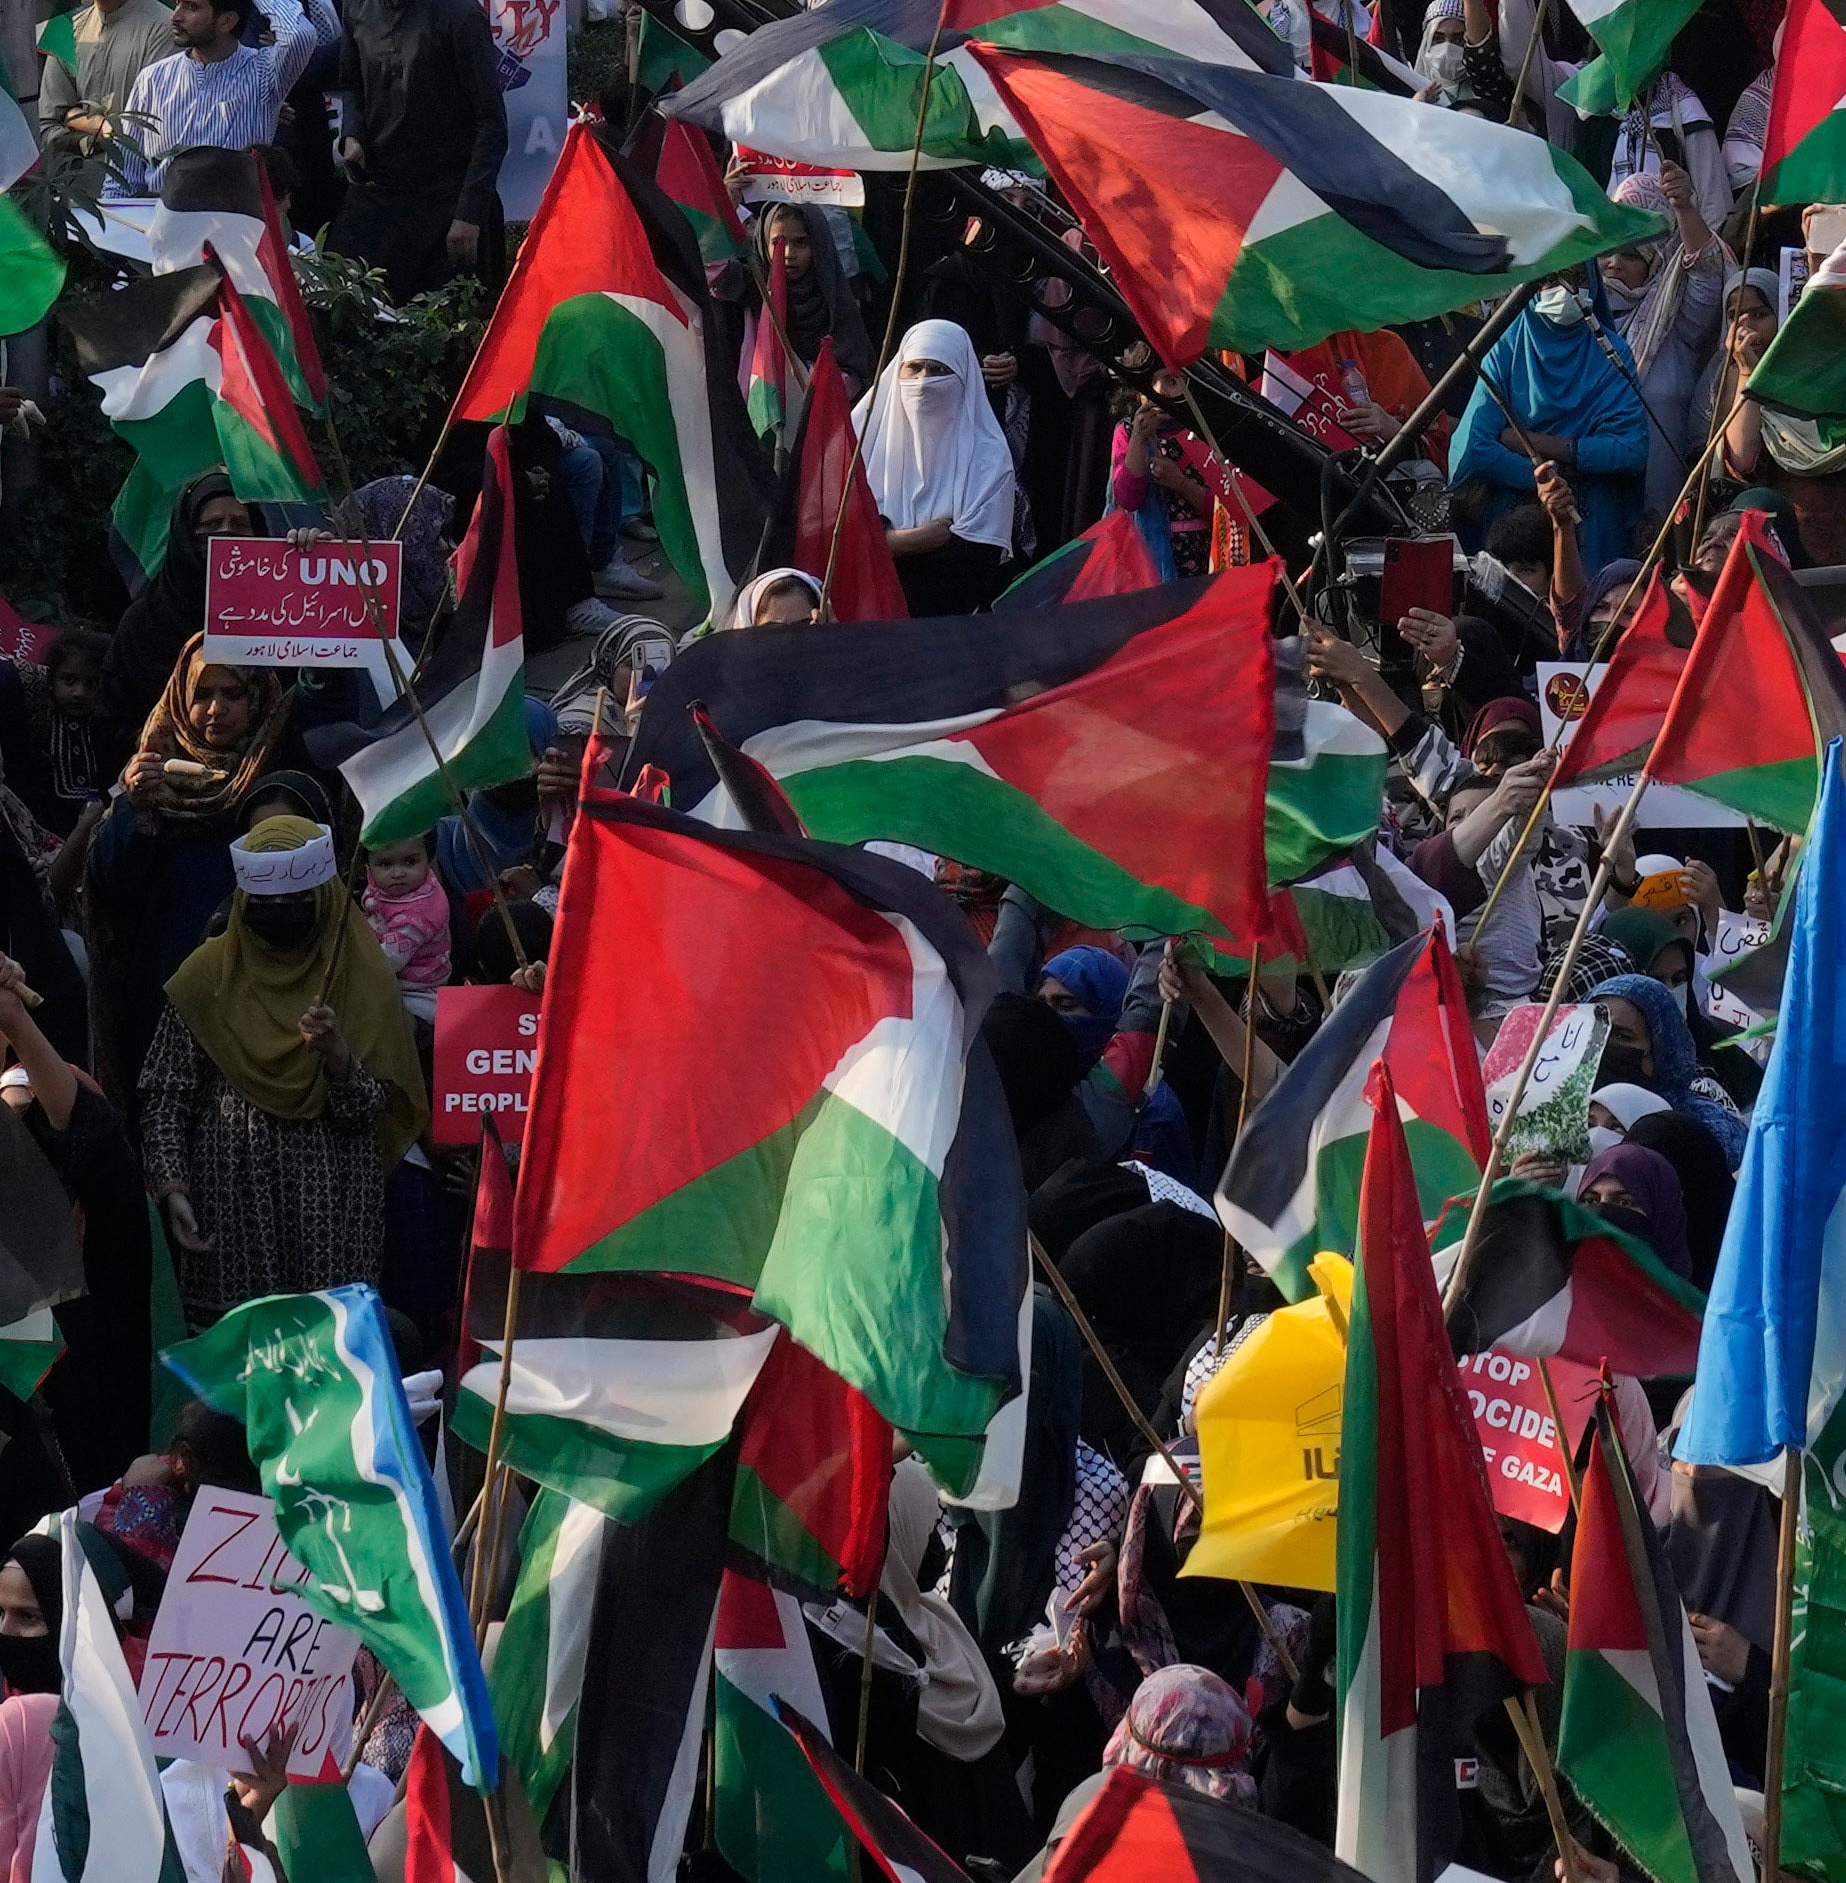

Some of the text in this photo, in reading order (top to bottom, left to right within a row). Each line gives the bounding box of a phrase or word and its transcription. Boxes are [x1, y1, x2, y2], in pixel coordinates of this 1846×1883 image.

[220, 546, 388, 586] UNO کی خاموشی
[218, 590, 347, 630] اسرائیل کی مدد ہے
[246, 641, 358, 660] جماعت اسلامی لاہور
[445, 1092, 530, 1112] PEOPL
[1467, 1391, 1558, 1449] OCIDE
[1500, 1455, 1564, 1497] GAZA
[243, 1606, 333, 1675] ARE
